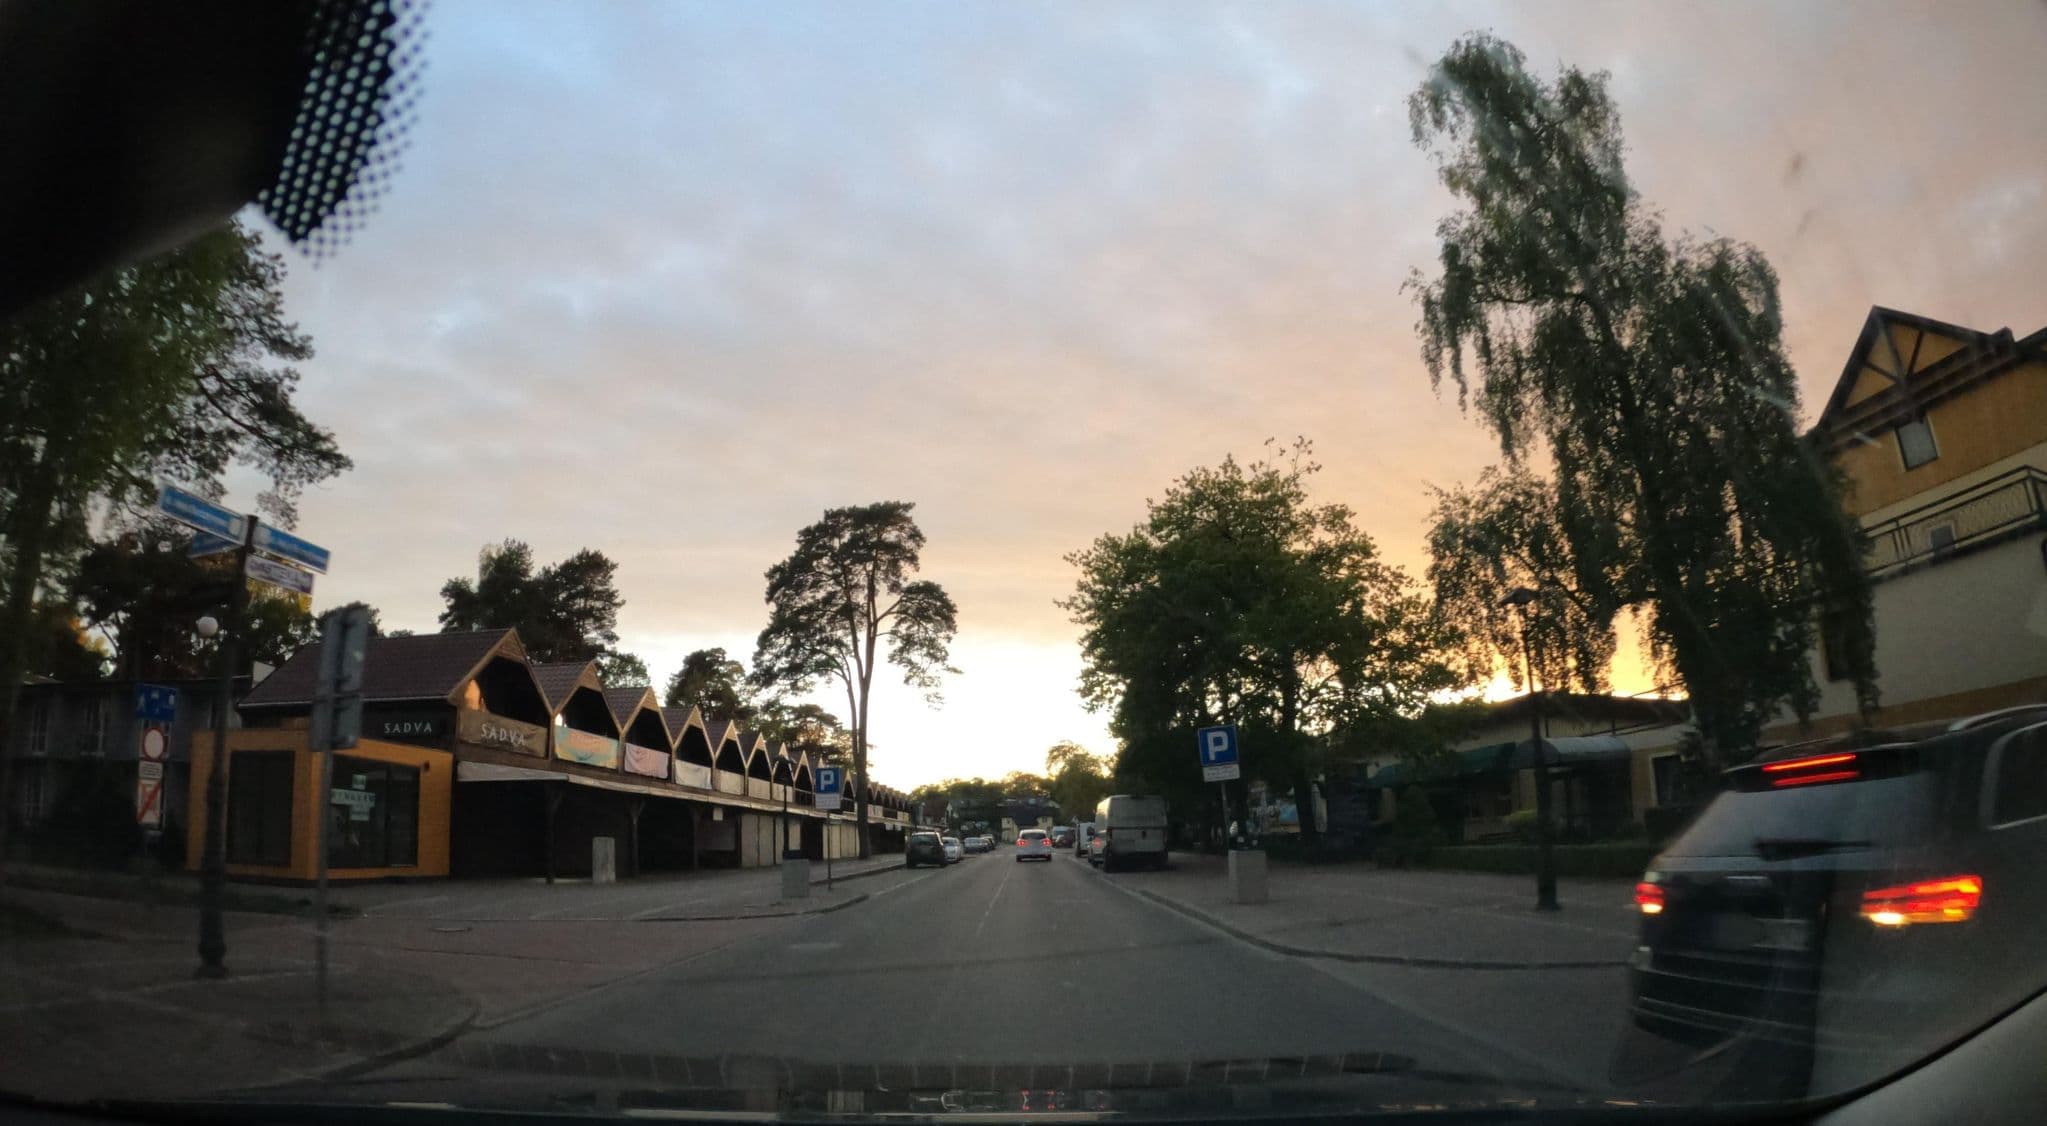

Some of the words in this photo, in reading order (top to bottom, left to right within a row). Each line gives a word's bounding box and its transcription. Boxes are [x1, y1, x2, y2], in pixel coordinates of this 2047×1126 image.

[384, 721, 433, 734] SADVA
[480, 723, 526, 746] SADVA
[1206, 730, 1229, 761] P
[820, 769, 835, 791] P
